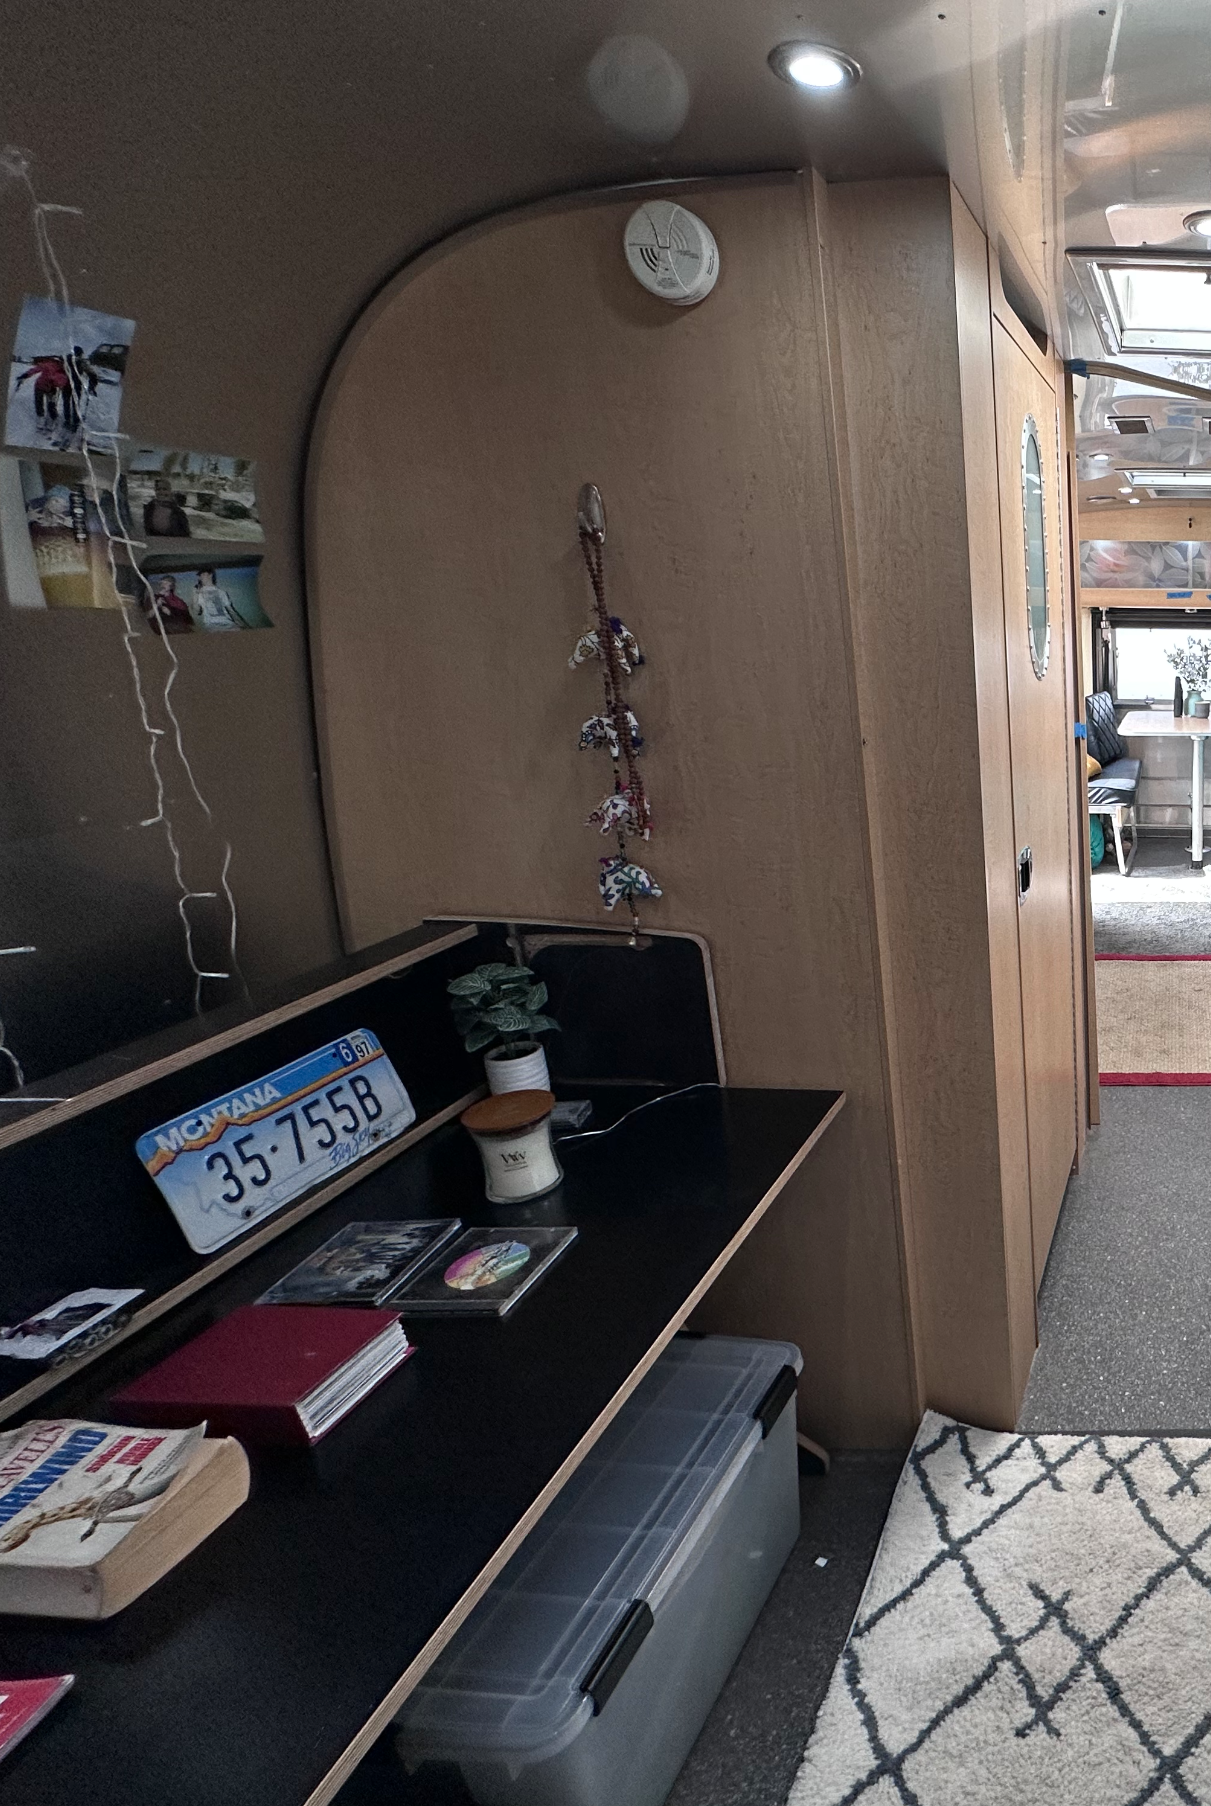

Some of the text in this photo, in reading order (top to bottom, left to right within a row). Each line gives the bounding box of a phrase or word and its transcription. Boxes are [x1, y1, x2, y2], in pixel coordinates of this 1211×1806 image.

[338, 1041, 371, 1062] 6 97
[154, 1081, 283, 1153] MONTANA
